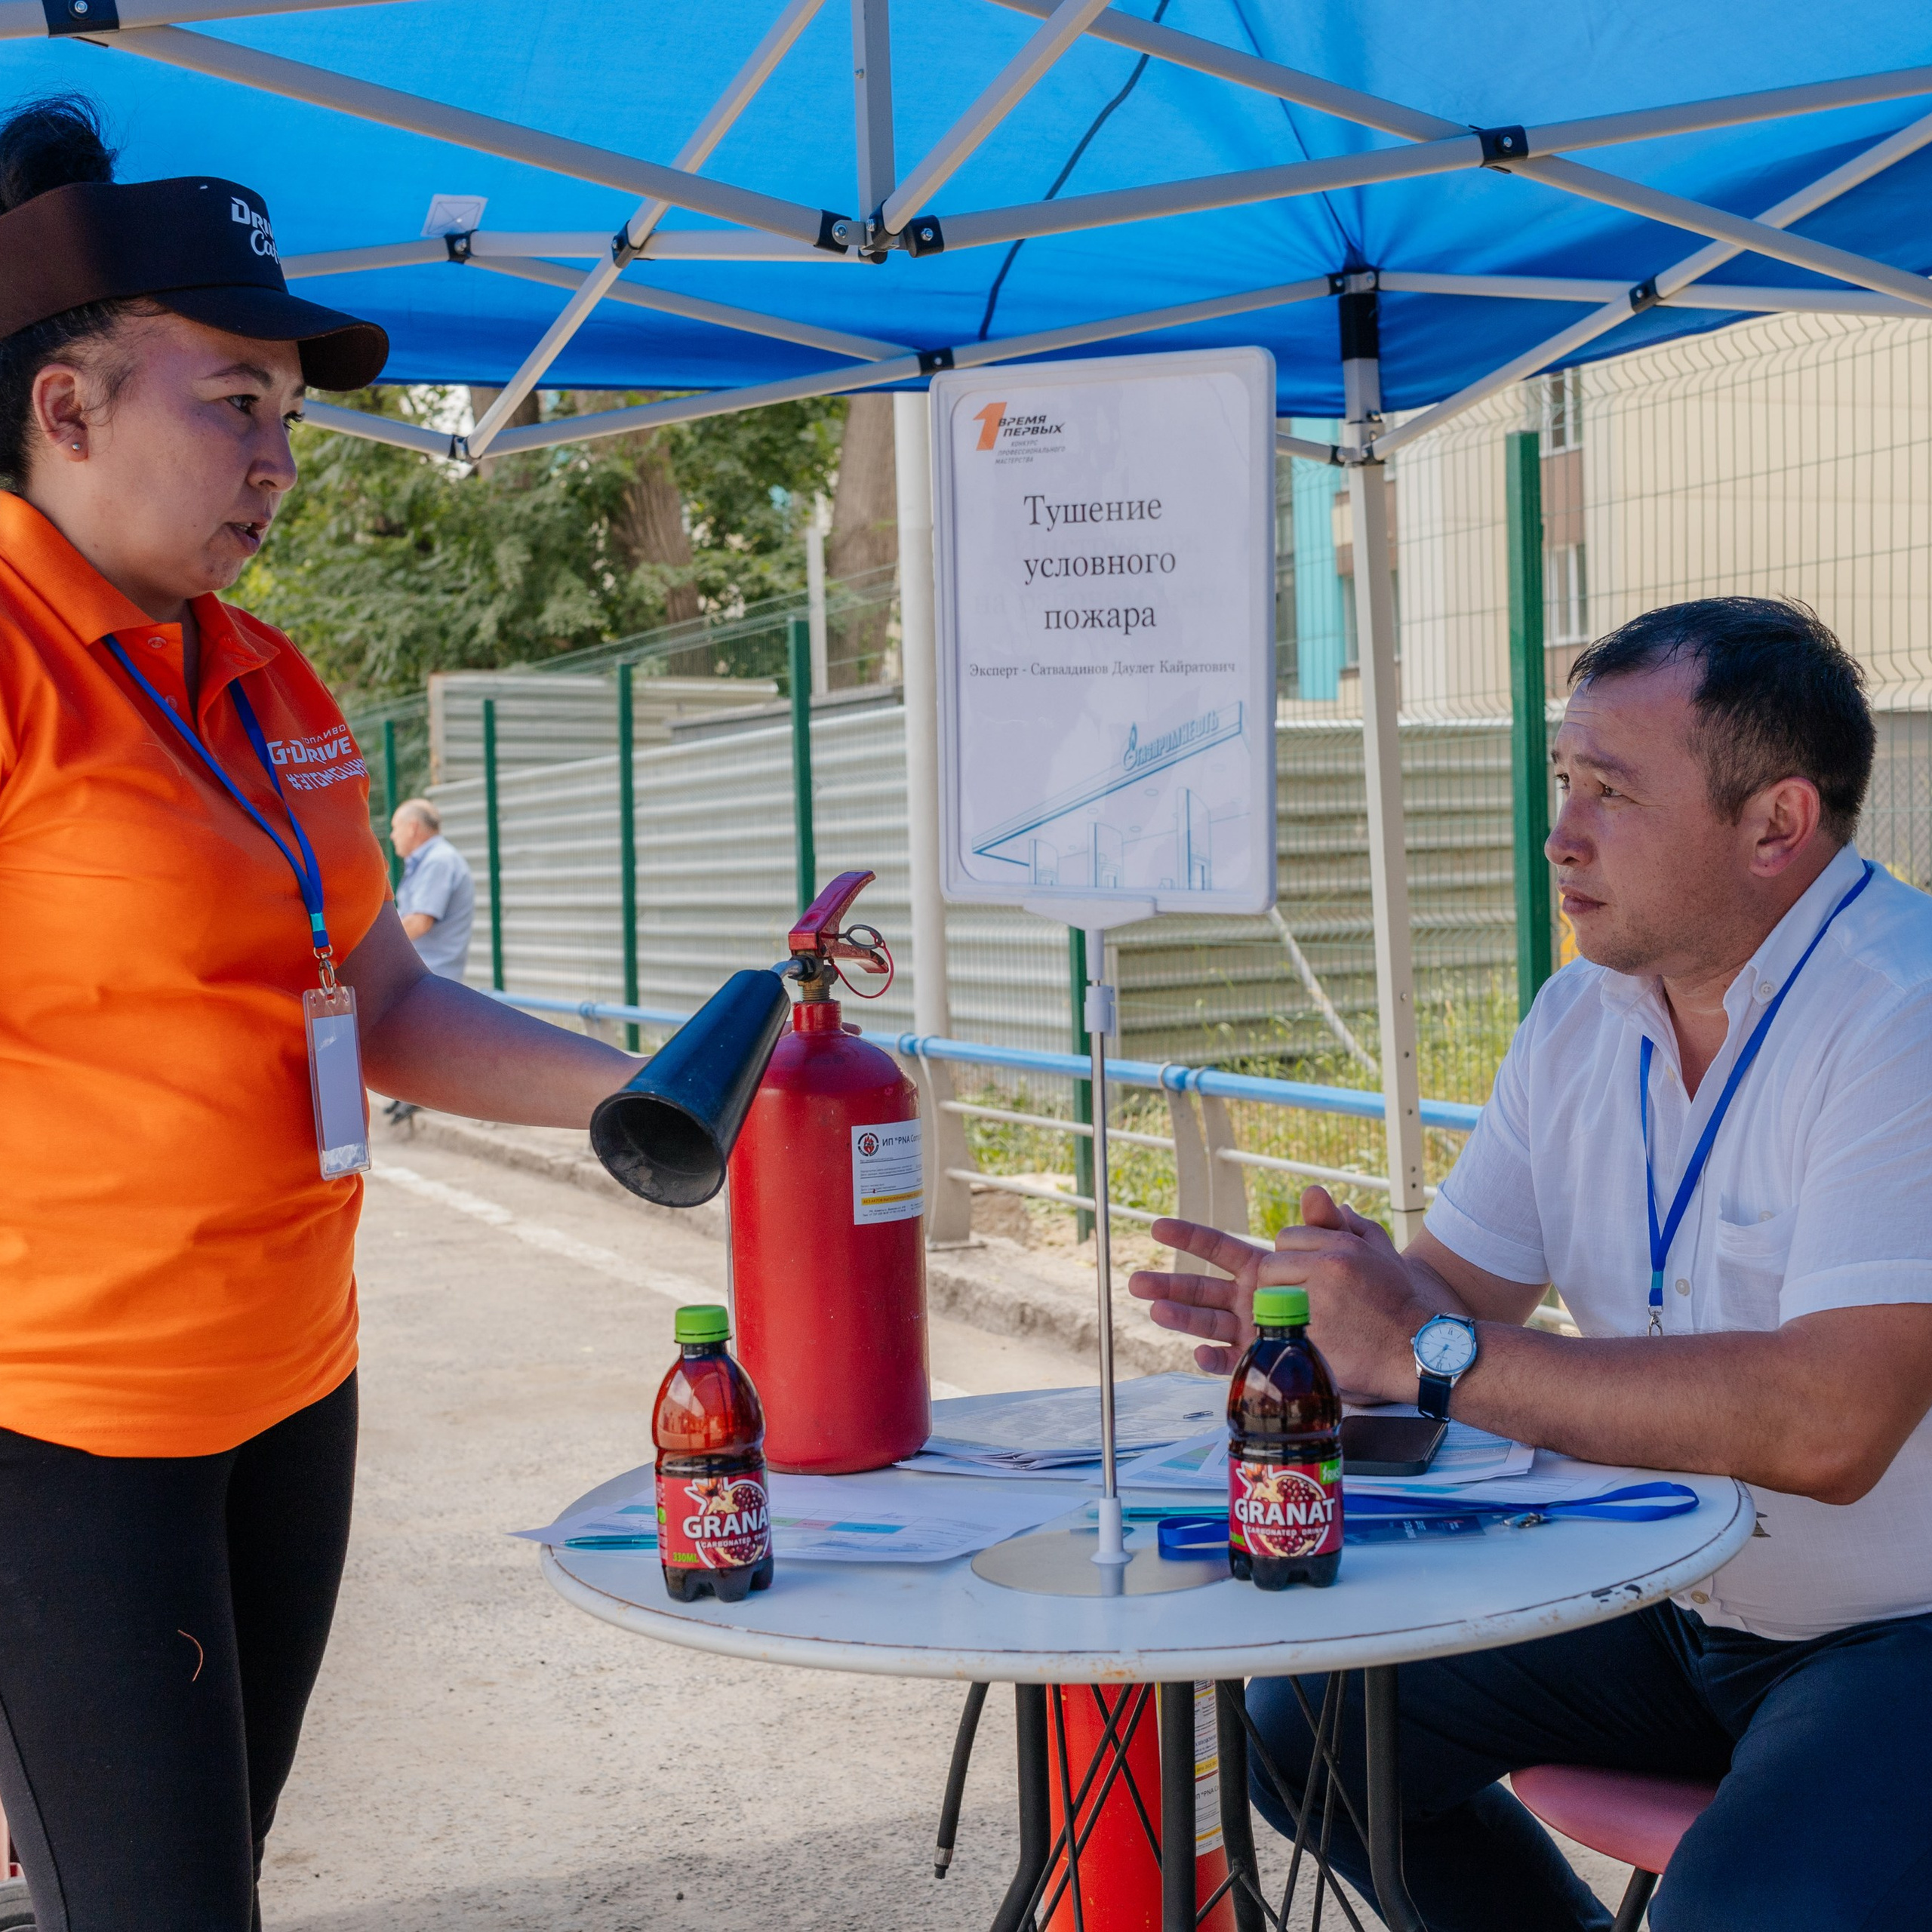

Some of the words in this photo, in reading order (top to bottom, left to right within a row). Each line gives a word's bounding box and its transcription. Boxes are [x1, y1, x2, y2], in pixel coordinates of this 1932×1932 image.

[998, 415, 1048, 427] ВРЕМЯ
[1003, 422, 1066, 437] ПЕРВЫХ
[1011, 439, 1039, 448] КОНКУРС
[995, 456, 1034, 465] МАСТЕРСТВА
[1023, 494, 1163, 532] Тушение
[1023, 552, 1177, 586] условного
[1044, 606, 1157, 635] пожара
[969, 663, 1019, 679] Эксперт
[1112, 660, 1155, 677] Даулет
[1159, 660, 1236, 676] Кайратович
[301, 724, 346, 744] ОПЛИВО
[285, 758, 368, 791] #ЭТОМОЩН
[882, 1137, 894, 1147] ИП
[1234, 1498, 1336, 1526] GRANAT
[682, 1506, 768, 1539] GRANA
[1247, 1525, 1297, 1537] CARBONATED
[701, 1537, 752, 1549] CARBONATED
